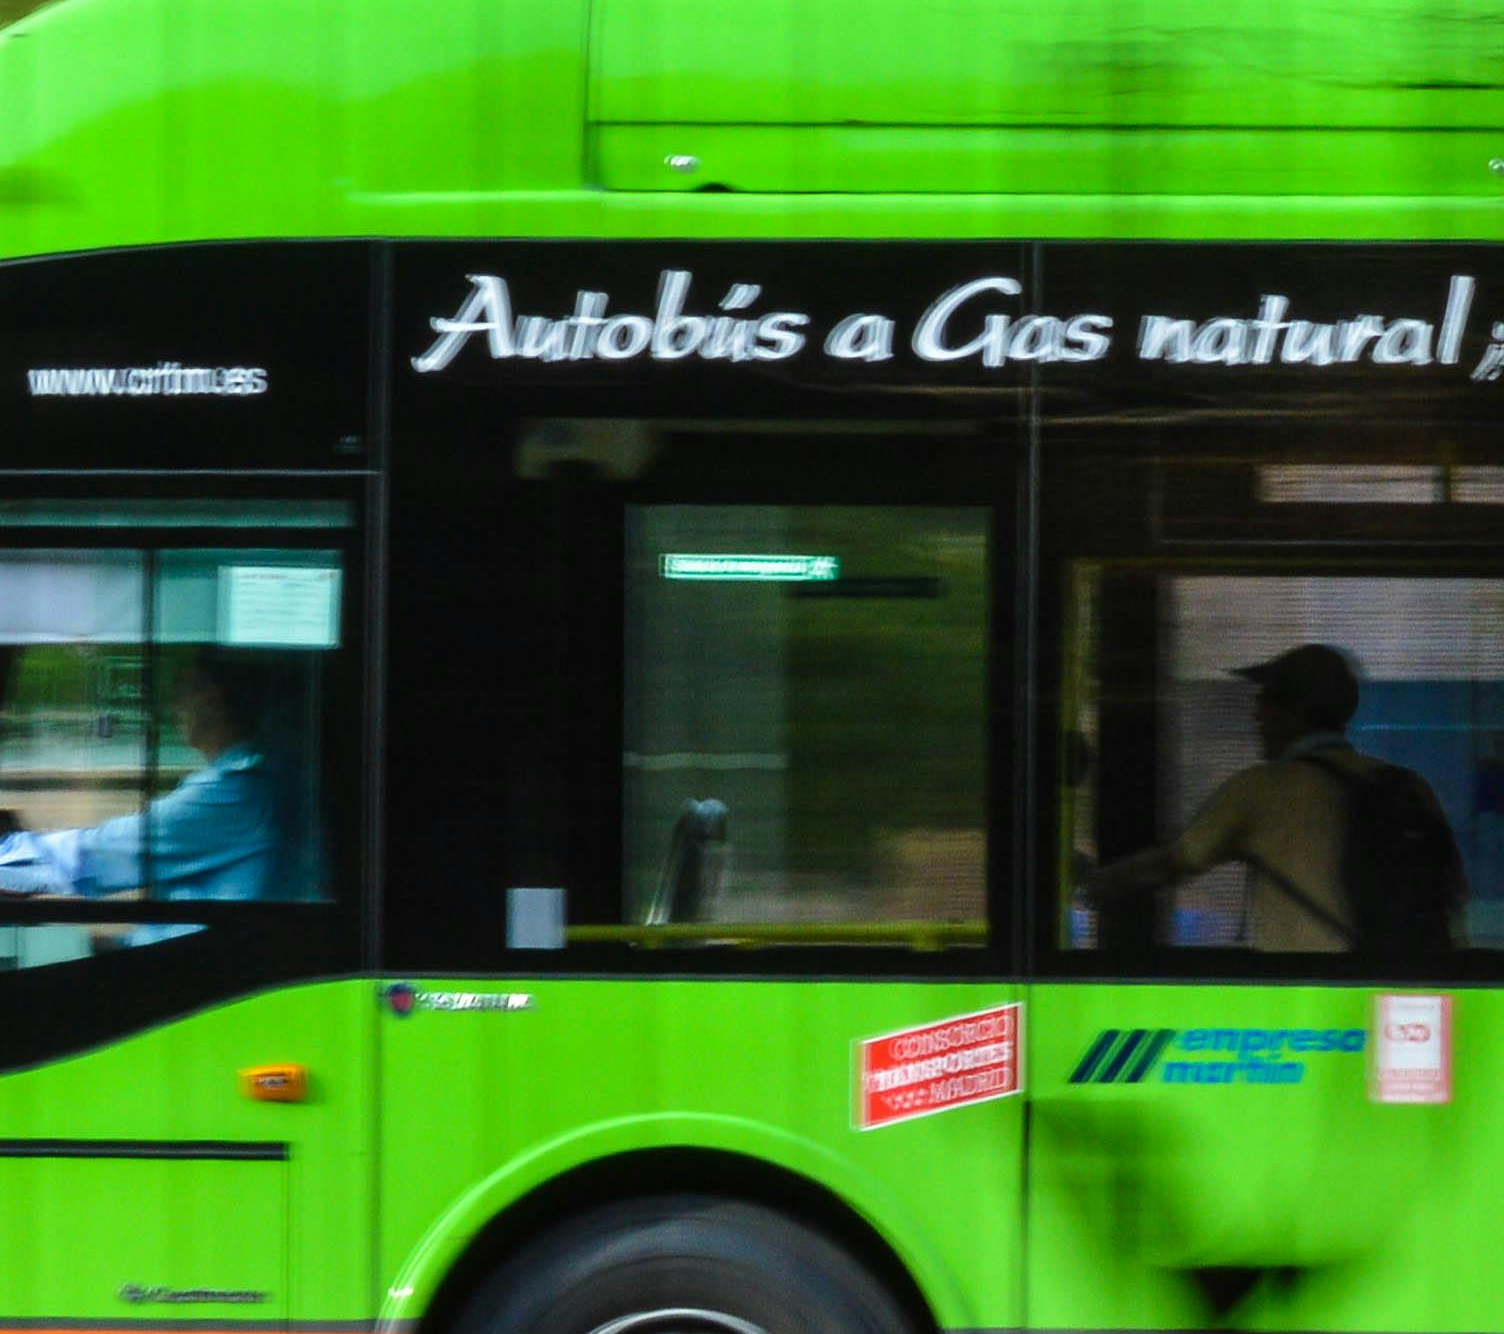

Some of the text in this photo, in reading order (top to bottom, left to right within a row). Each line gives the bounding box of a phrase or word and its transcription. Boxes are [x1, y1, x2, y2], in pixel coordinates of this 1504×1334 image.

[411, 270, 809, 373] Autobús
[824, 314, 895, 362] a
[912, 277, 1113, 367] Gas
